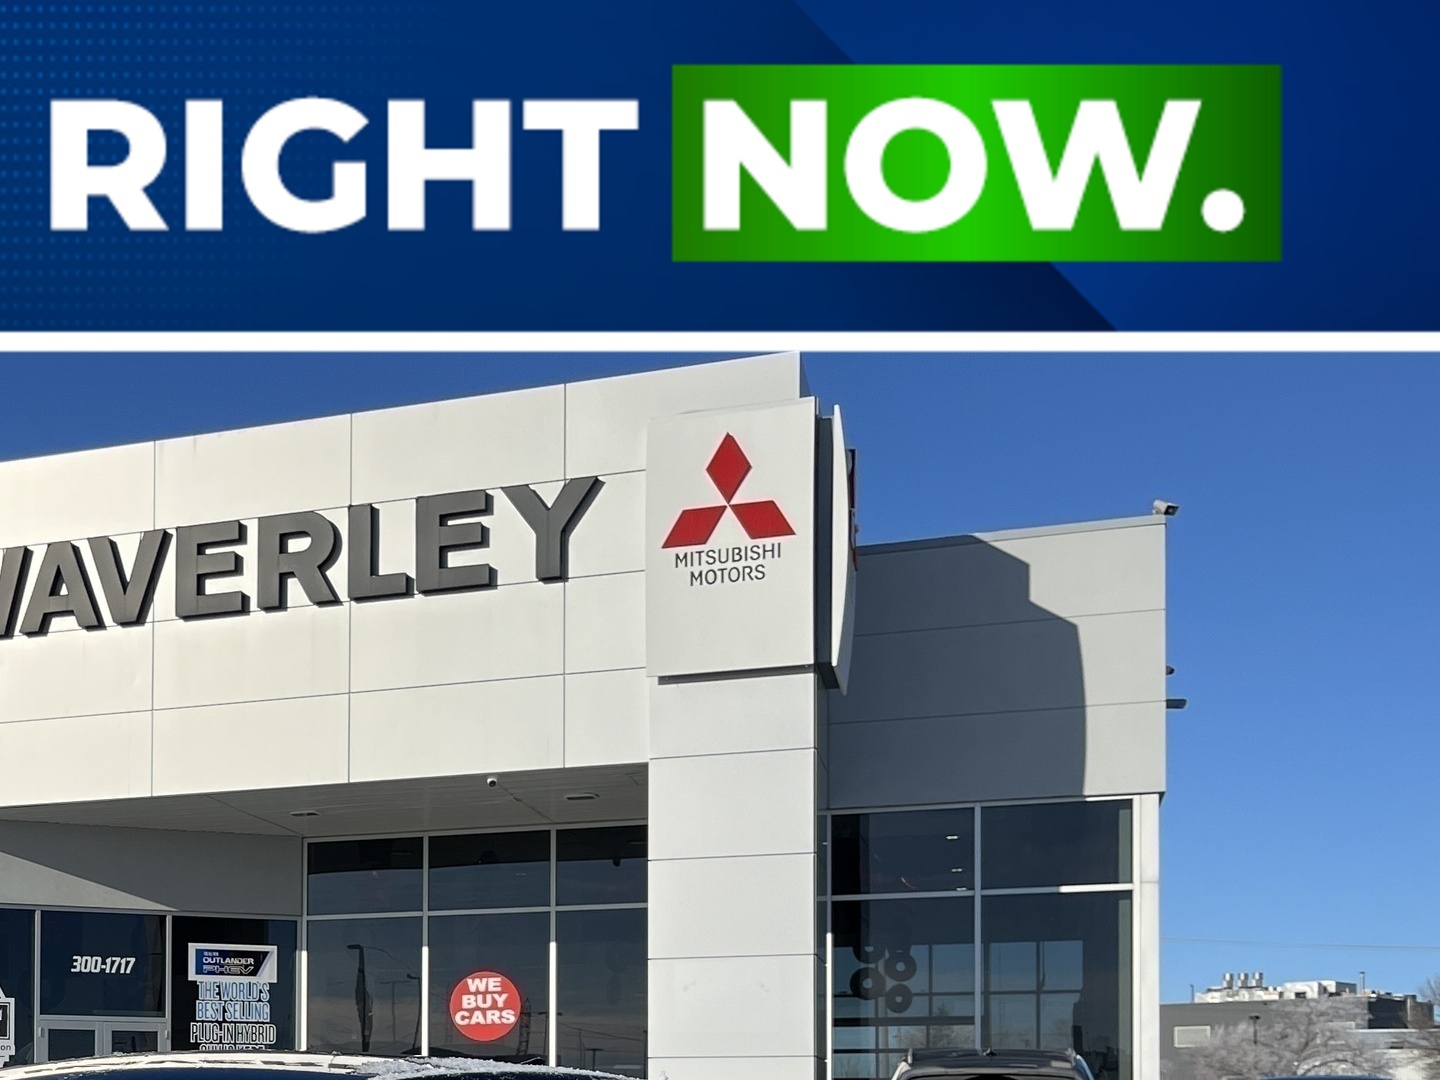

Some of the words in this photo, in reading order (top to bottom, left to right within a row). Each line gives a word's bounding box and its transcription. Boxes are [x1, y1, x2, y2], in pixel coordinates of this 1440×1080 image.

[675, 543, 782, 568] MITSUBISHI
[690, 564, 766, 587] MOTORS
[71, 955, 136, 974] 300-1717
[202, 957, 255, 965] OUTLANDER
[203, 965, 254, 974] PHEV
[197, 981, 219, 1000] THE
[220, 981, 269, 1001] WORLD'S
[466, 977, 502, 992] WE
[196, 1000, 224, 1021] BEST
[225, 1001, 270, 1022] SELLING
[461, 994, 509, 1009] BUY
[454, 1009, 516, 1026] CARS
[190, 1022, 235, 1043] PLUG-IN
[235, 1023, 277, 1044] HYBRID
